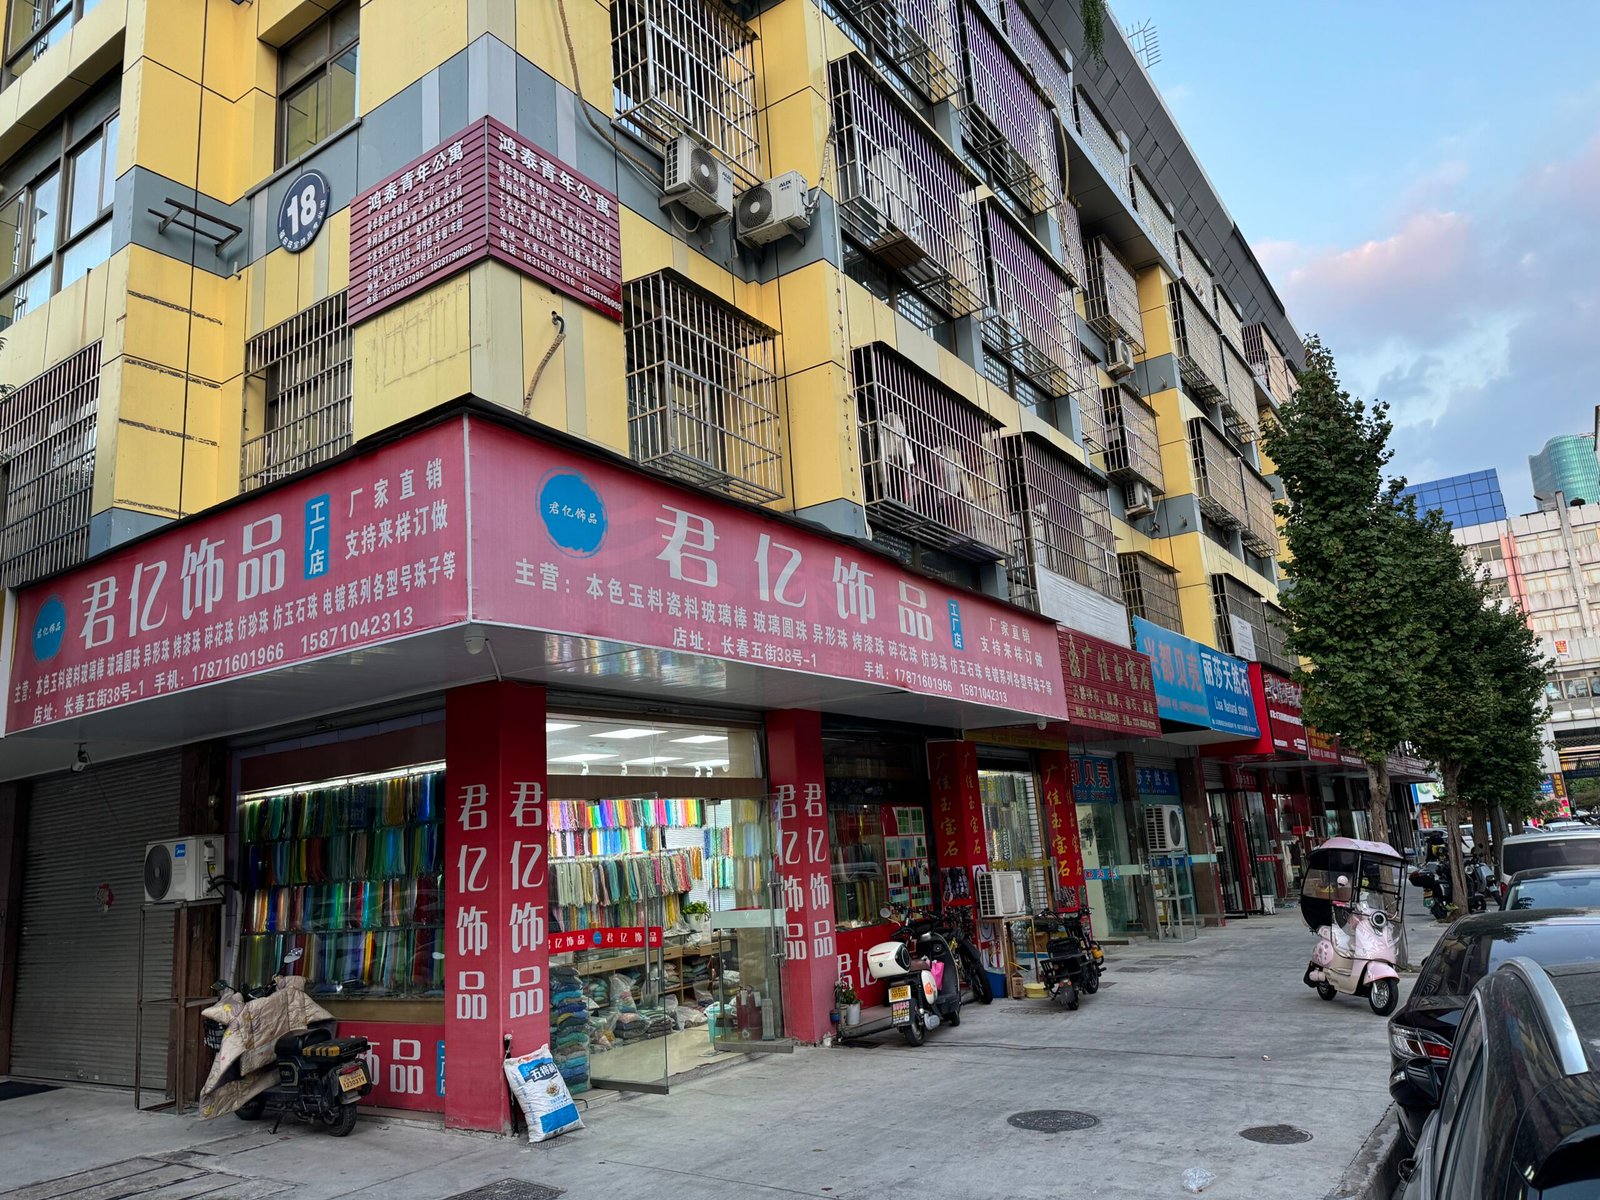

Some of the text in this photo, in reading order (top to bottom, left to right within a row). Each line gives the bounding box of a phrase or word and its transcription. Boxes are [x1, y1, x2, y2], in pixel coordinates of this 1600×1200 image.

[368, 140, 464, 214] 鸿泰青年公寓
[499, 132, 610, 218] 鸿泰青年公寓
[287, 184, 316, 236] 18
[348, 457, 442, 517] 厂家直销
[548, 501, 598, 525] 君亿饰品
[309, 502, 326, 575] 工厂店
[344, 500, 448, 560] 支持来样订做
[80, 513, 284, 650] 君亿饰品
[655, 504, 933, 642] 君亿饰品
[273, 592, 318, 631] 仿玉石珠
[300, 605, 413, 654] 15871042313
[951, 603, 962, 648] 工厂店
[989, 617, 1031, 644] 厂家直销
[960, 683, 1008, 703] 15871042313
[1201, 652, 1249, 696] 丽莎天然石
[1045, 764, 1070, 876] 广佳玉宝石
[509, 781, 544, 1019] 君亿饰品
[804, 784, 833, 958] 君亿饰品
[456, 784, 490, 1020] 君亿饰品
